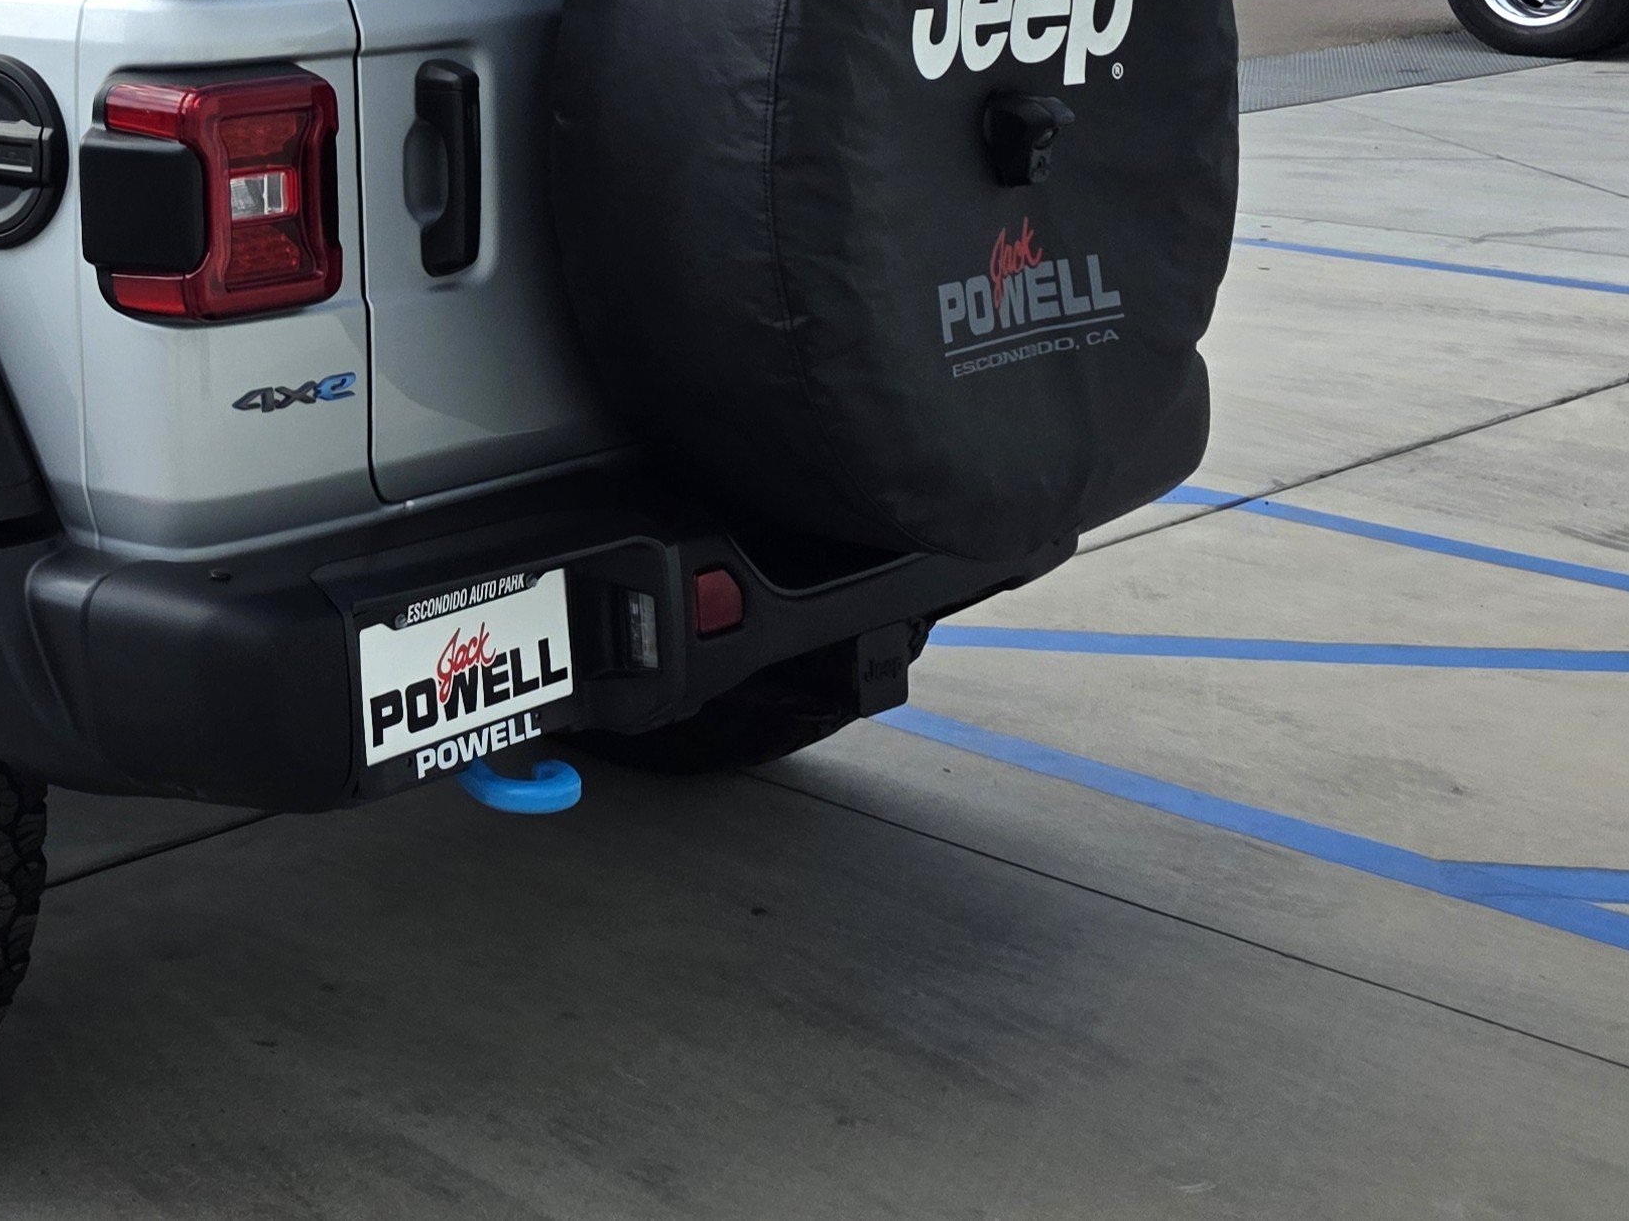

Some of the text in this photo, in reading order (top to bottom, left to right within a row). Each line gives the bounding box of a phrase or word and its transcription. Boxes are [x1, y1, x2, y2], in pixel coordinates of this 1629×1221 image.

[938, 254, 1122, 344] POWELL
[990, 216, 1044, 310] Jack
[1086, 328, 1120, 346] CA
[406, 572, 525, 625] ESCONDIDO AUTO PARK
[369, 637, 569, 747] POWELL
[437, 622, 497, 703] Jack
[417, 712, 542, 778] POWELL
